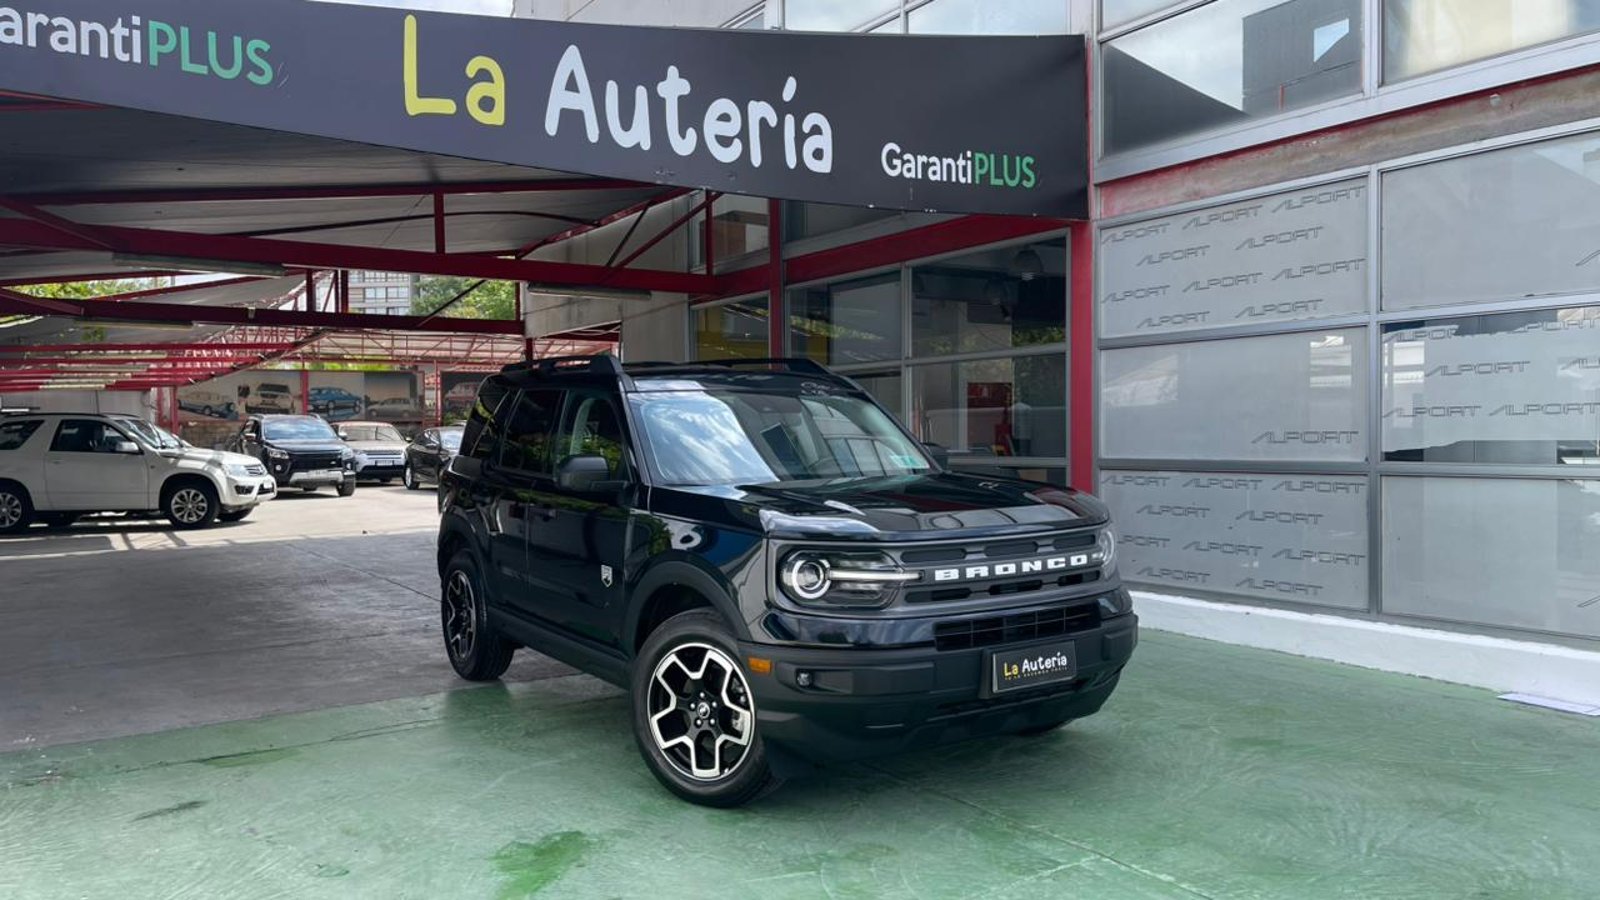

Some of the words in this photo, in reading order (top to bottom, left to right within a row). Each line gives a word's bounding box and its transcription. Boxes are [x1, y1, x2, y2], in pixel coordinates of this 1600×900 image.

[0, 6, 274, 86] arantiPLUS
[403, 14, 506, 127] La
[544, 44, 833, 174] Autería
[881, 142, 1036, 189] GarantiPLUS
[1101, 223, 1170, 245] ALPORT
[1182, 205, 1263, 230] ALPORT
[1271, 185, 1366, 213] ALPORT
[1136, 245, 1210, 267] ALPORT
[1235, 226, 1324, 251] ALPORT
[1101, 285, 1170, 304] ALPORT
[1182, 272, 1263, 292] ALPORT
[1271, 258, 1366, 281] ALPORT
[1137, 311, 1210, 329] ALPORT
[1234, 299, 1323, 318] ALPORT
[1424, 360, 1531, 378] ALPORT
[1383, 405, 1482, 419] ALPORT
[1489, 402, 1600, 416] ALPORT
[1251, 431, 1359, 445] ALPORT
[1101, 475, 1171, 487] ALPORT
[1182, 477, 1263, 491] ALPORT
[1272, 480, 1365, 495] ALPORT
[1136, 504, 1210, 519] ALPORT
[1235, 510, 1324, 526] ALPORT
[1182, 540, 1263, 557] ALPORT
[1272, 548, 1366, 566] ALPORT
[935, 554, 1088, 581] BRONCO
[1136, 566, 1210, 584] ALPORT
[1235, 577, 1323, 596] ALPORT
[1003, 661, 1019, 677] La
[1022, 651, 1067, 673] Autería
